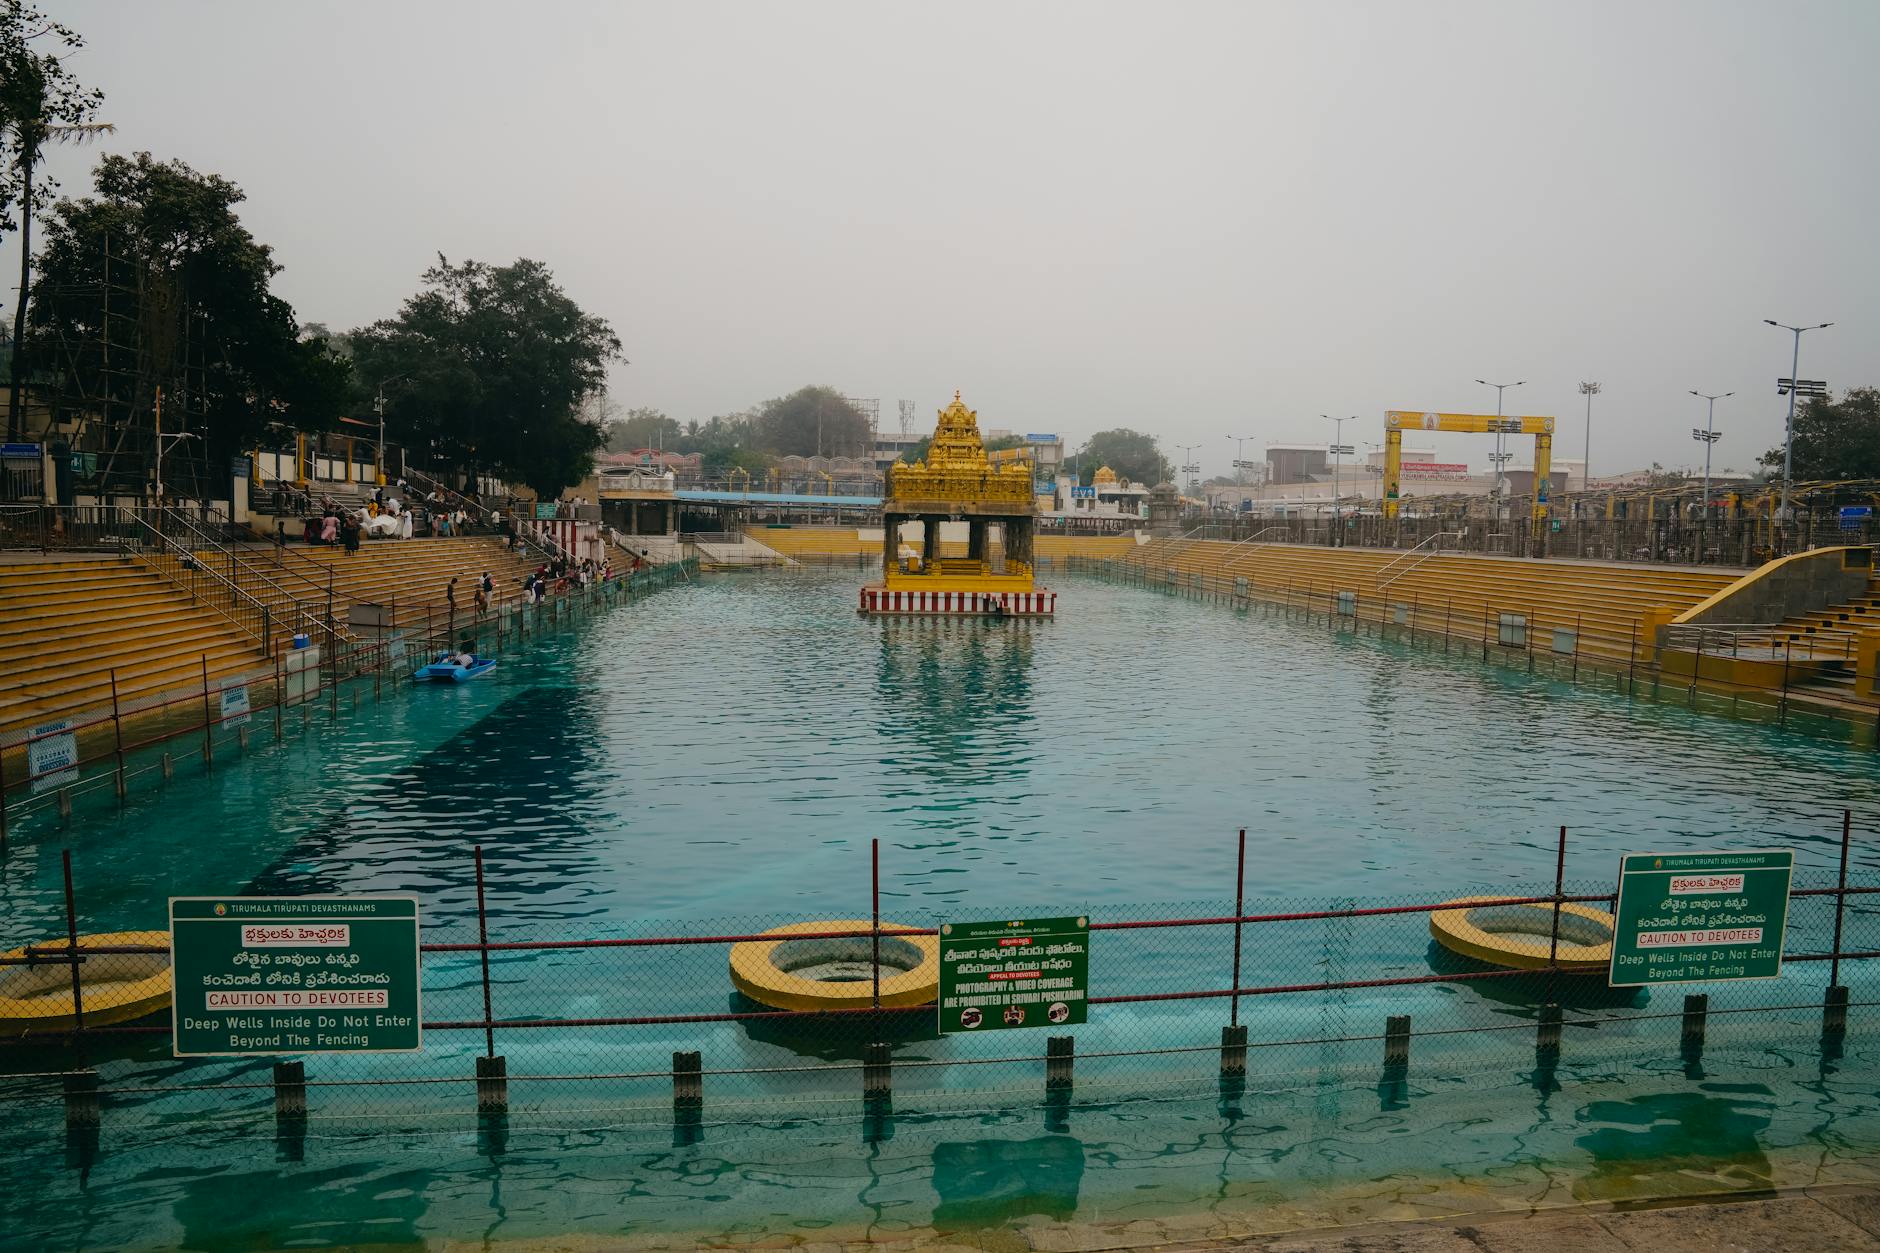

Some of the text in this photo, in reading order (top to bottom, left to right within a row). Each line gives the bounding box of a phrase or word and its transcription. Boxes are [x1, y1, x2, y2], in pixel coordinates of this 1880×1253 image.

[231, 904, 376, 913] TIRUMALA TIRUPATI DEVASTHANAMS
[1639, 929, 1761, 944] CAUTION TO DEVOTEES
[274, 952, 321, 967] బావులు
[325, 952, 360, 968] ఉన్నవి
[1619, 949, 1777, 966] Deep Wells Inside Do Not Enter
[1648, 965, 1745, 980] Beyond The Fencing
[955, 977, 1074, 994] PHOTOGRAPHY & VIDEO COVERAGE
[209, 992, 385, 1006] CAUTION TO DEVOTEES
[944, 998, 958, 1008] ARE
[958, 995, 1002, 1007] PROHIBITED
[1002, 995, 1011, 1005] IN
[1011, 993, 1041, 1005] SRIVARI
[184, 1015, 412, 1031] Deep Wells Inside Do Not Enter
[230, 1033, 369, 1049] Beyond The Fencing
